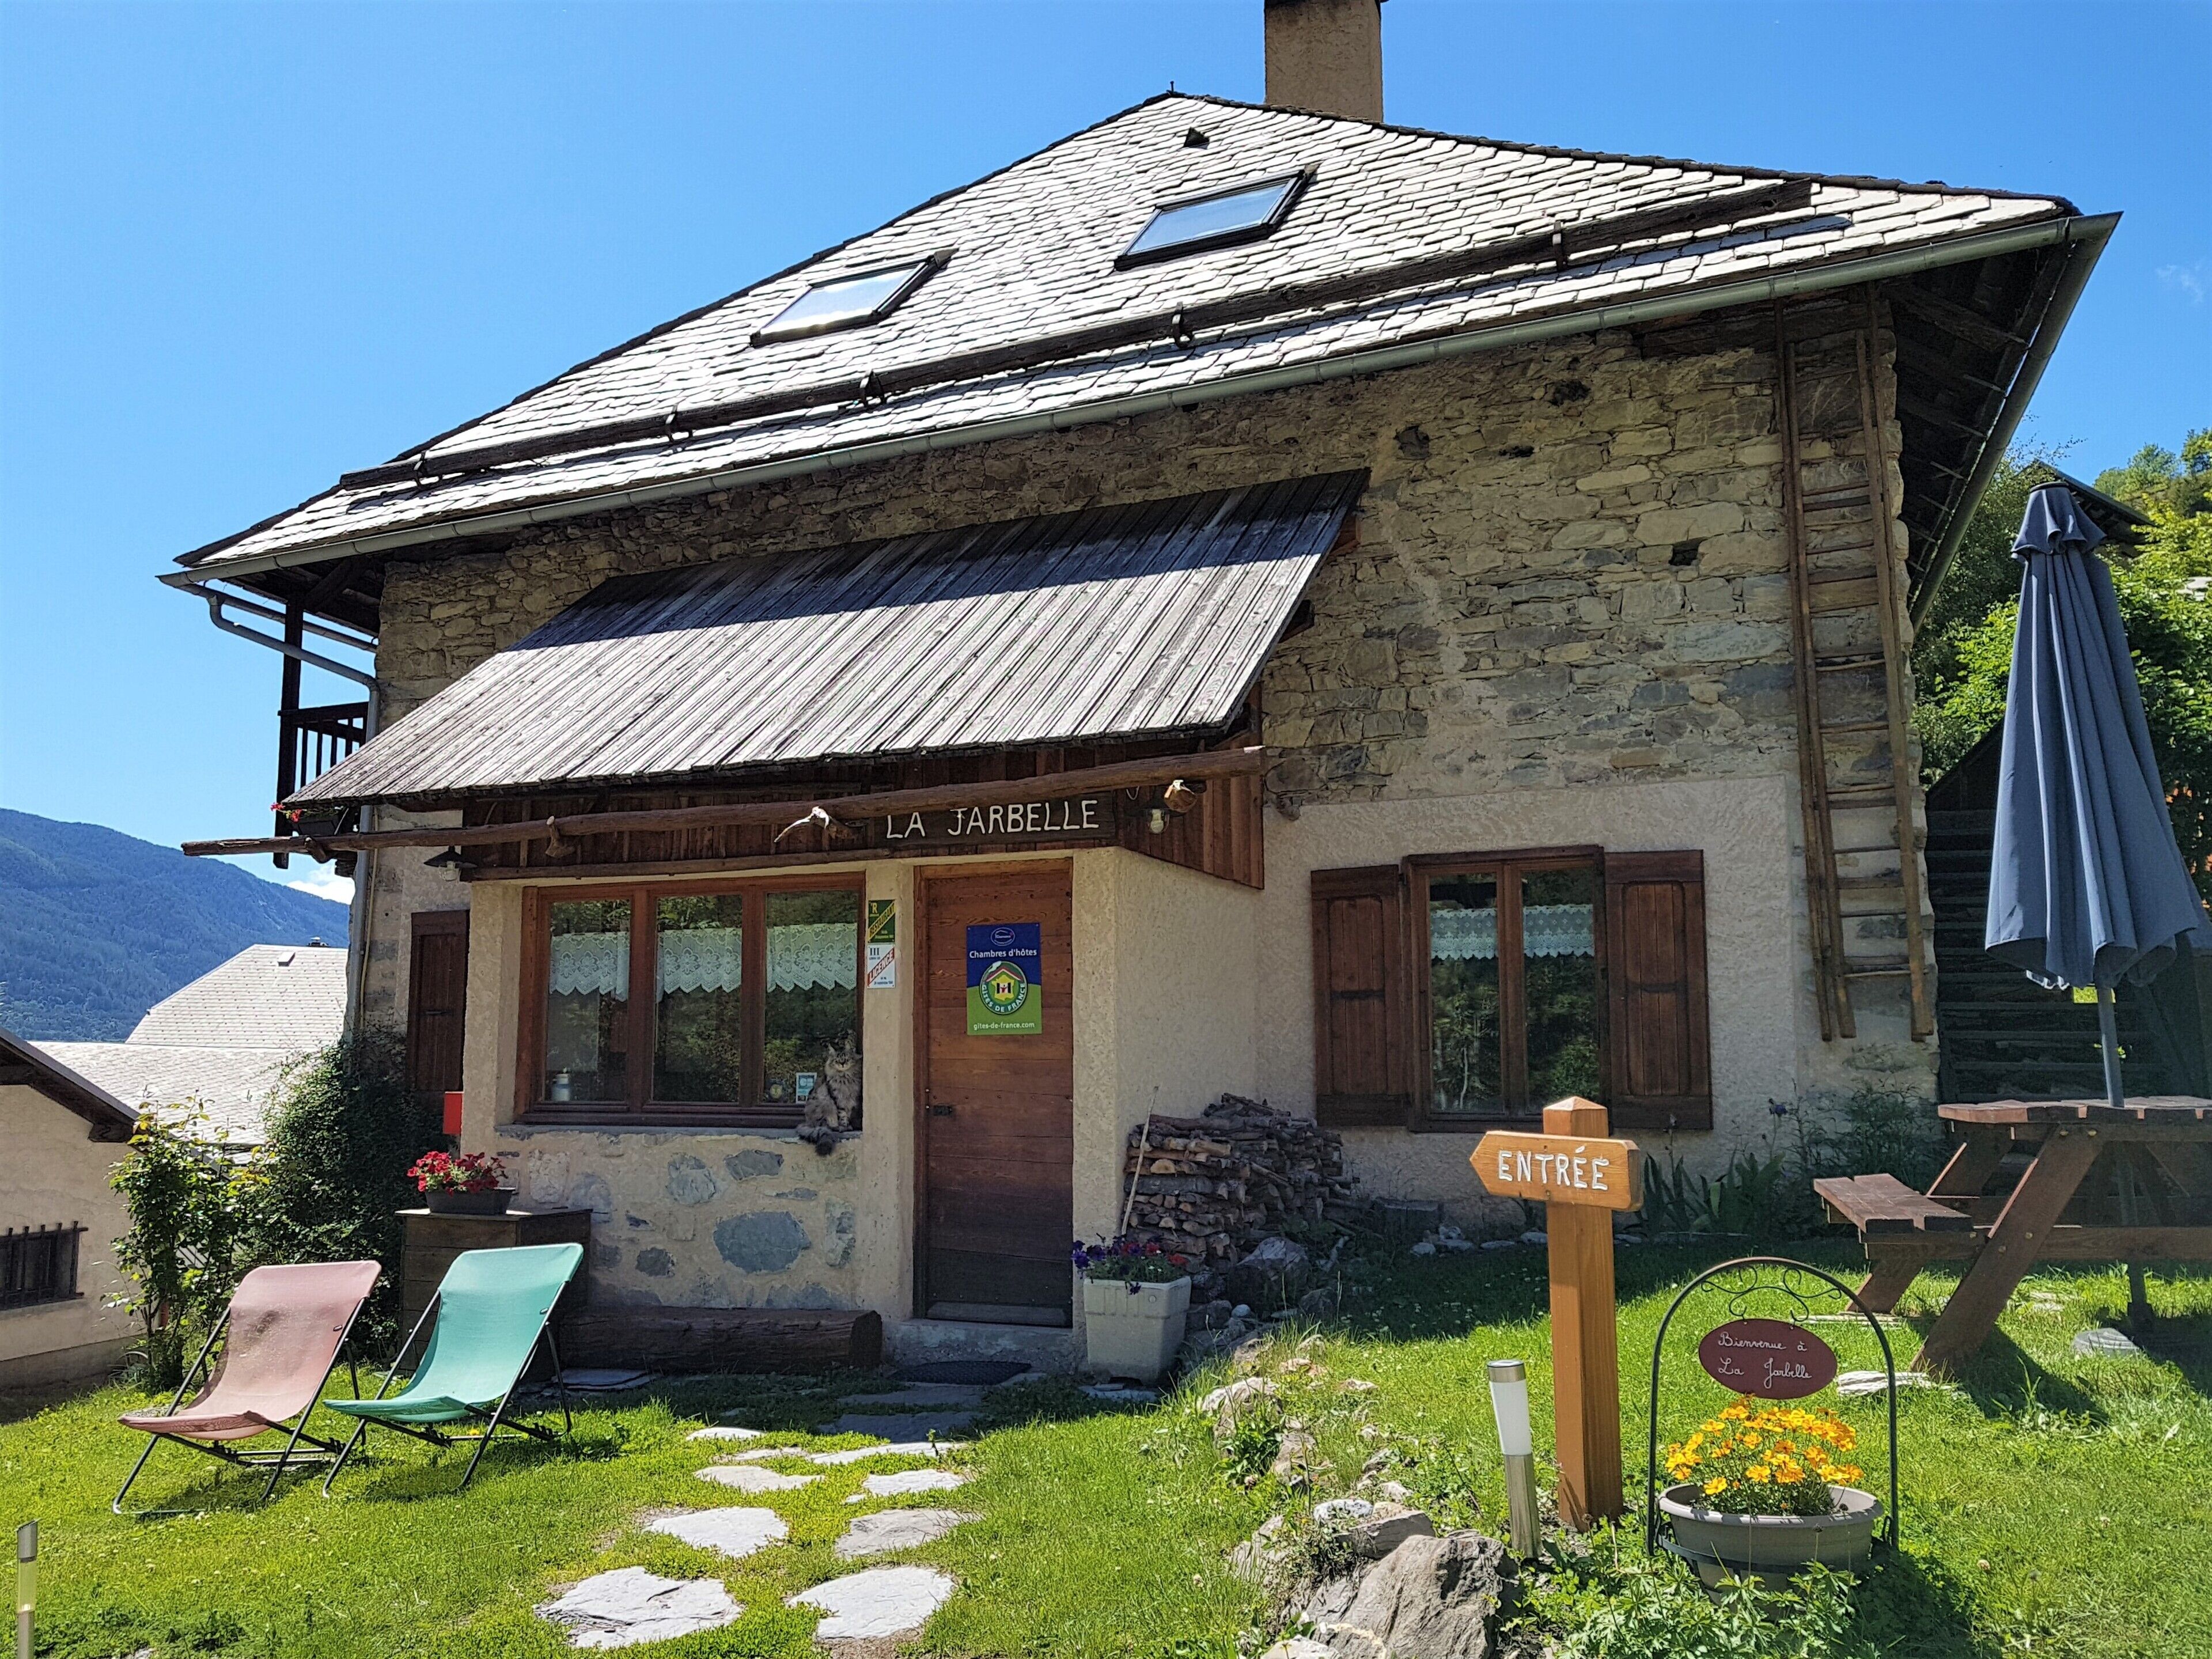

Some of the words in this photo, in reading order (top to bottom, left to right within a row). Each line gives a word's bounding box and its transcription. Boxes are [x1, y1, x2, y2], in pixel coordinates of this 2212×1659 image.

[887, 812, 925, 839] LA
[948, 800, 1099, 836] JARBELLE
[869, 903, 895, 938] RESTAURANT
[869, 948, 894, 982] LICENCE
[969, 949, 1006, 958] Chambres
[1008, 948, 1037, 956] d'hôtes
[1007, 983, 1025, 1012] FRANCE
[1498, 1145, 1609, 1191] ENTRÉE
[1718, 1331, 1787, 1350] Bienvenue
[1797, 1341, 1807, 1351] à
[1718, 1357, 1744, 1375] La
[1763, 1358, 1812, 1389] Jarbelle
